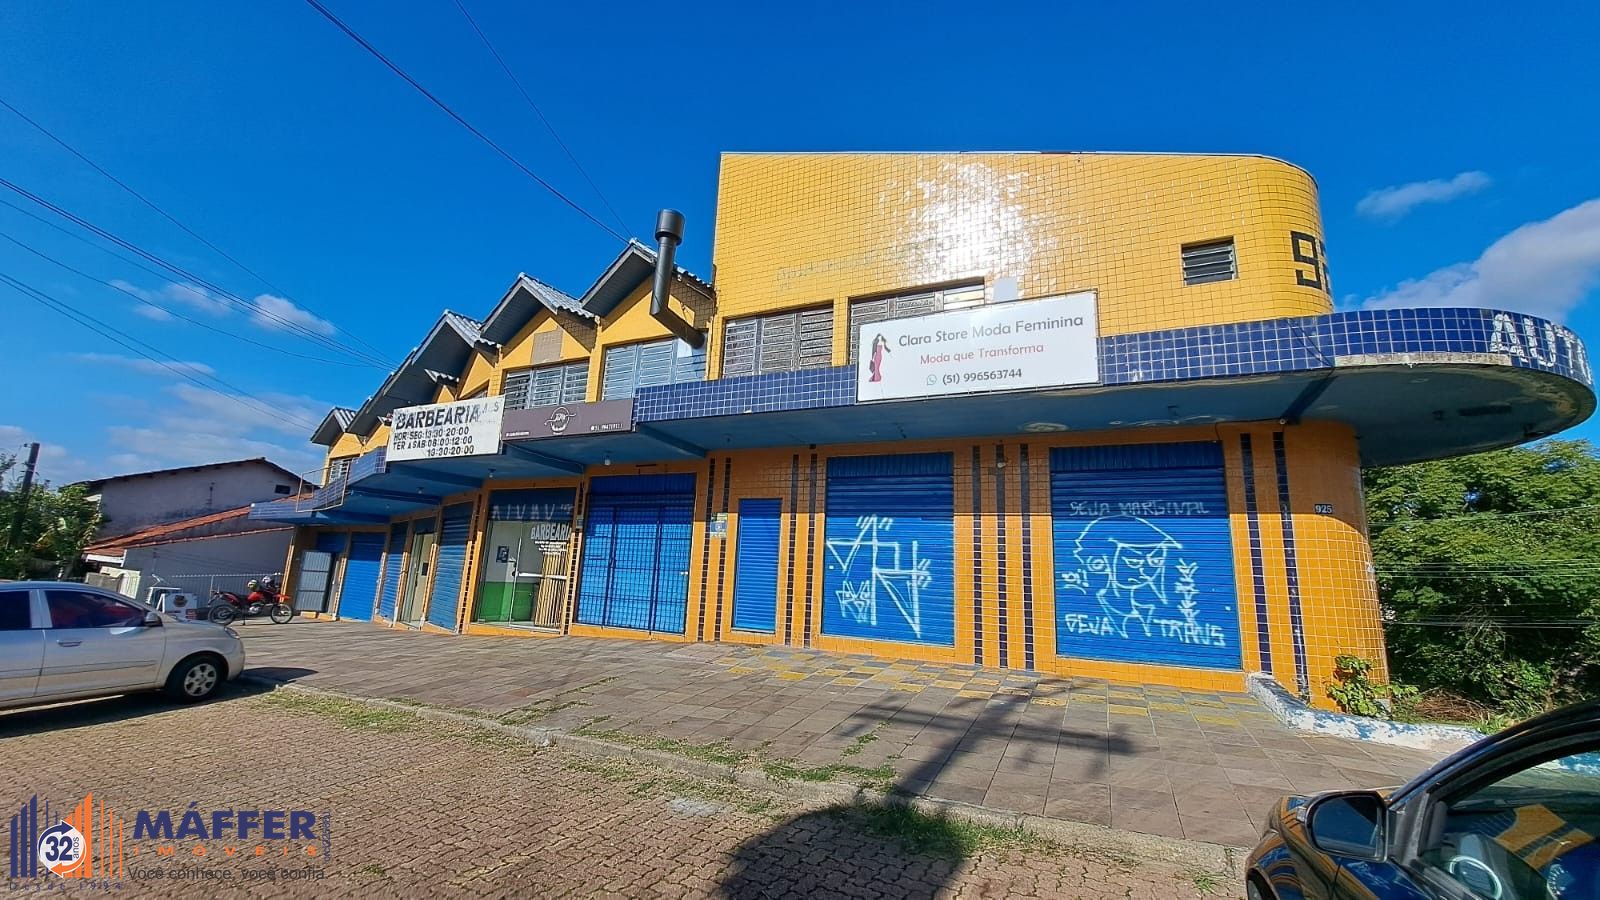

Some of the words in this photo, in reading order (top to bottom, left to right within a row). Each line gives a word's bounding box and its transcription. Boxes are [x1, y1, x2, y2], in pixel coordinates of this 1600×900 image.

[898, 334, 932, 348] Clara
[935, 329, 968, 343] Store
[972, 322, 1011, 338] Moda
[1015, 314, 1084, 333] Feminina
[920, 352, 950, 365] Moda
[953, 351, 974, 364] que
[979, 343, 1044, 359] Transforma
[942, 373, 961, 385] (51)
[963, 368, 1022, 383] 996563744
[395, 404, 480, 431] BARBEARIA
[1315, 504, 1333, 514] 925
